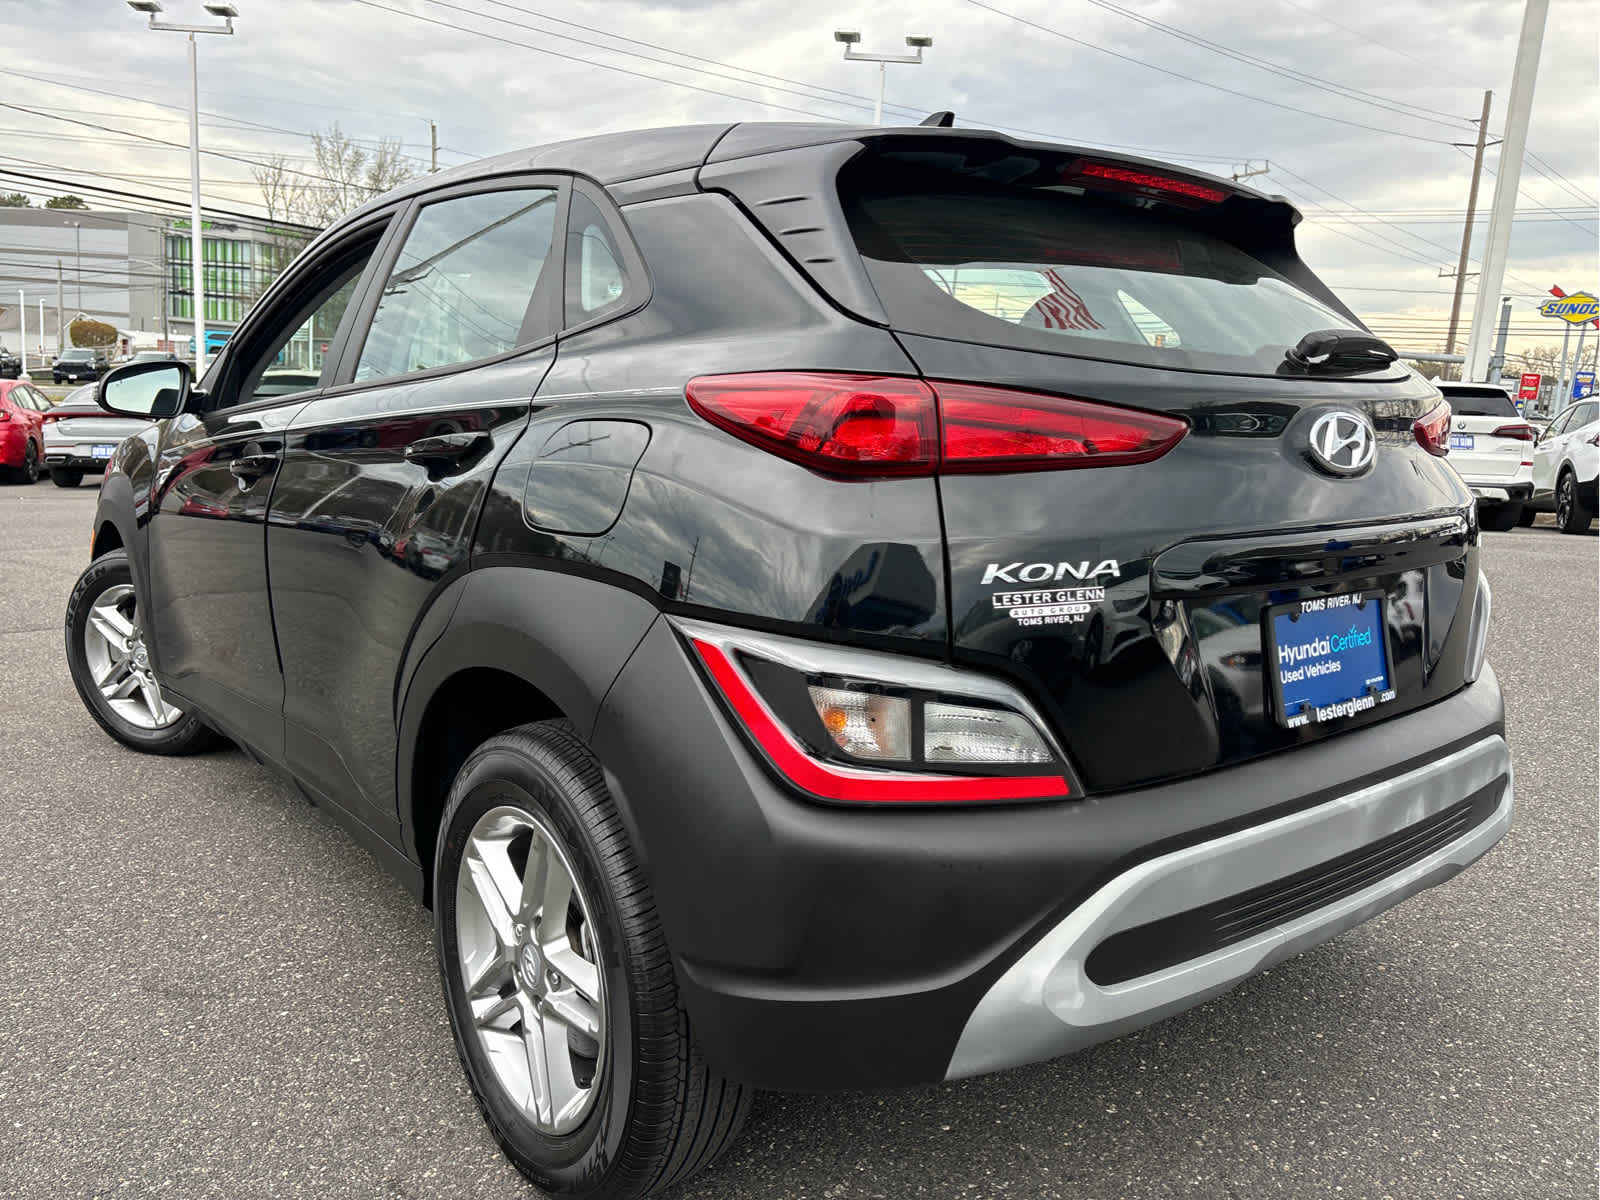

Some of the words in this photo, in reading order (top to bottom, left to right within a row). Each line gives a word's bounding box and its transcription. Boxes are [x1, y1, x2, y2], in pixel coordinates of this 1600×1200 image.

[980, 559, 1121, 585] KONA
[68, 565, 107, 629] NEXEN
[991, 592, 1051, 607] LESTER
[1056, 588, 1105, 602] GLENN
[1300, 598, 1326, 614] TOMS
[1352, 592, 1362, 605] NJ
[1013, 607, 1044, 616] AUTO
[1050, 605, 1088, 614] GROUP
[1017, 617, 1043, 626] TOMS
[1044, 615, 1073, 625] RIVER,
[1073, 614, 1084, 623] NJ
[1278, 635, 1331, 666] Hyundai
[1330, 624, 1372, 653] Certified
[1280, 666, 1305, 684] Used
[1305, 659, 1342, 679] Vehicles
[1315, 695, 1375, 722] lesterglenn
